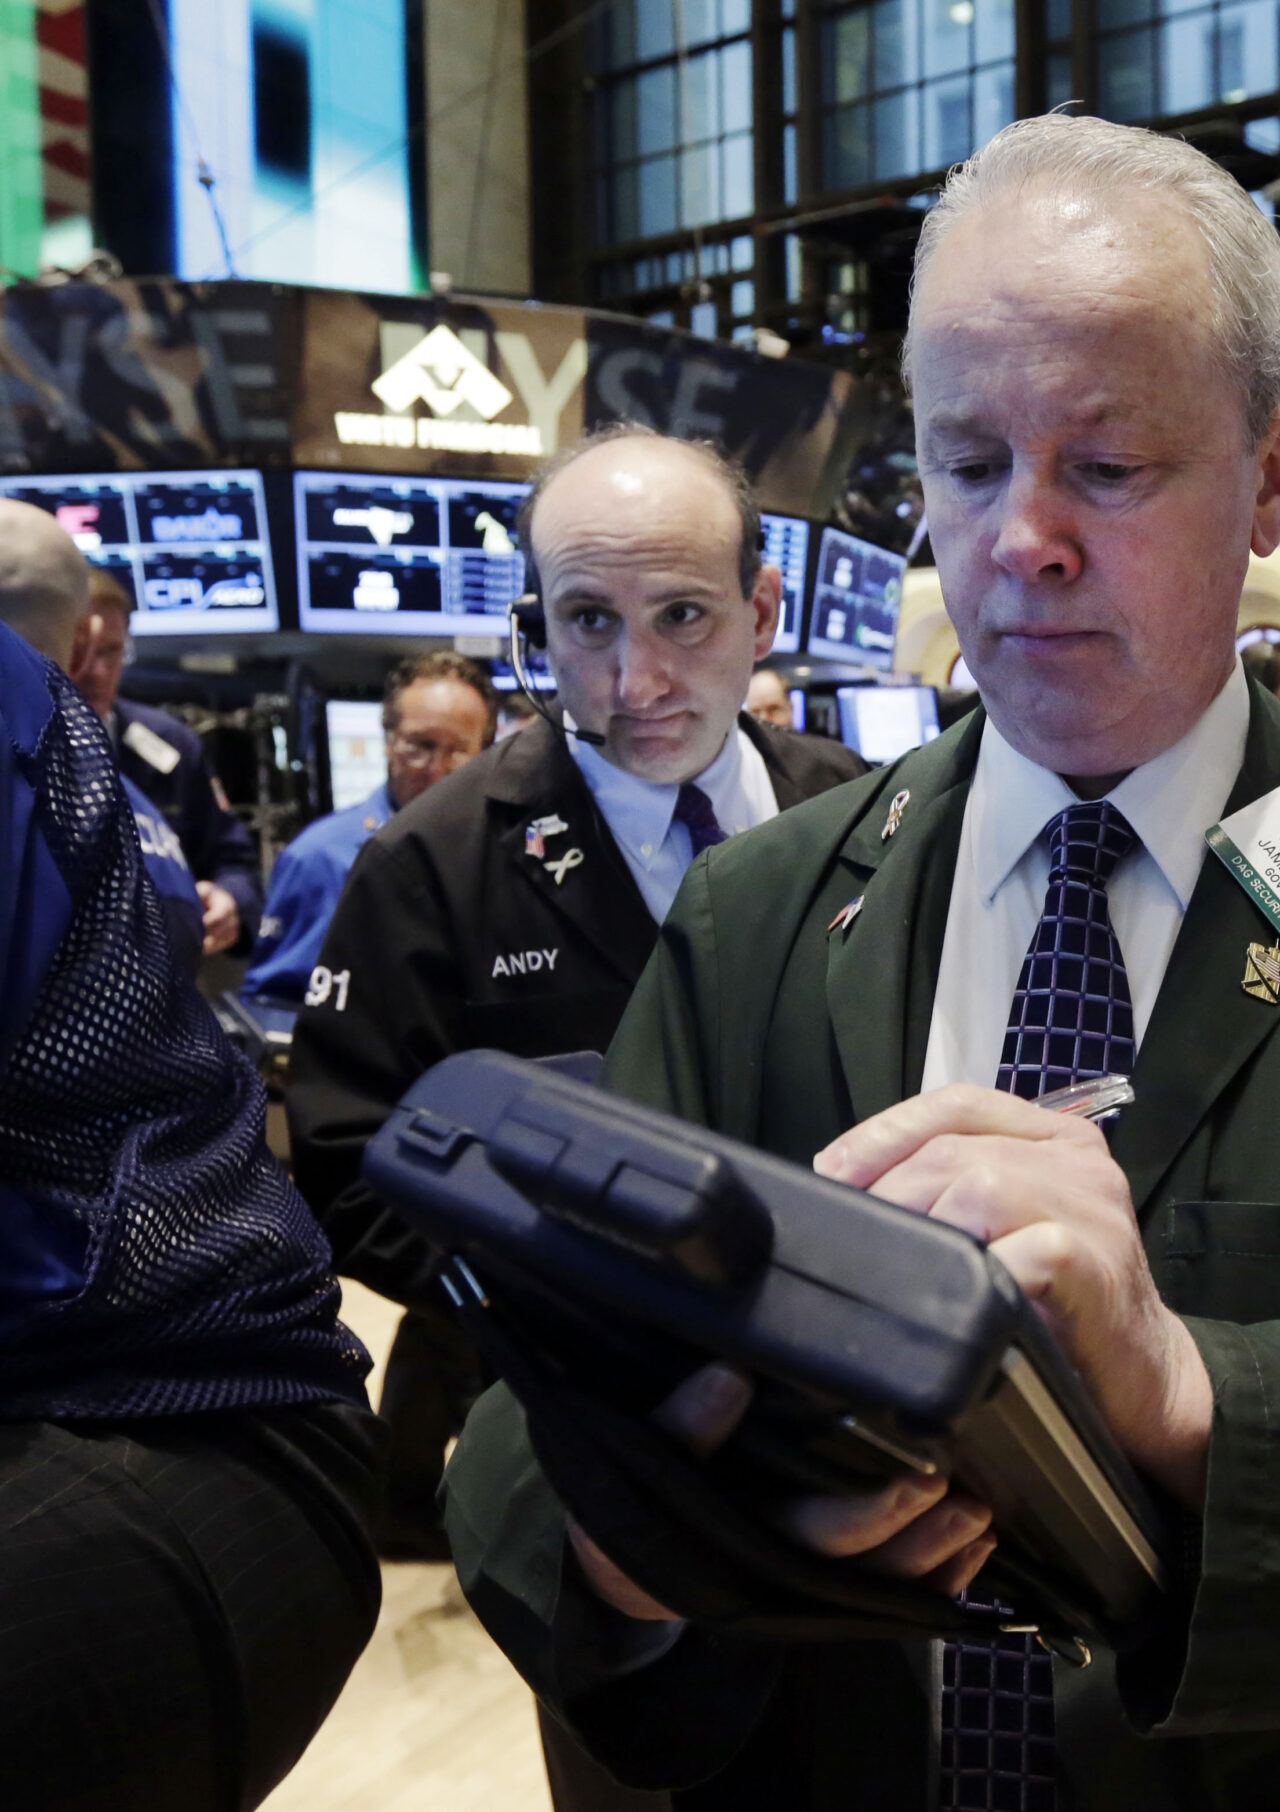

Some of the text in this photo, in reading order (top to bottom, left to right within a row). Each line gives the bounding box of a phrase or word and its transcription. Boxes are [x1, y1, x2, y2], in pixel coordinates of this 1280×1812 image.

[1231, 855, 1254, 879] DAG
[491, 948, 559, 978] ANDY
[304, 965, 351, 1012] 91
